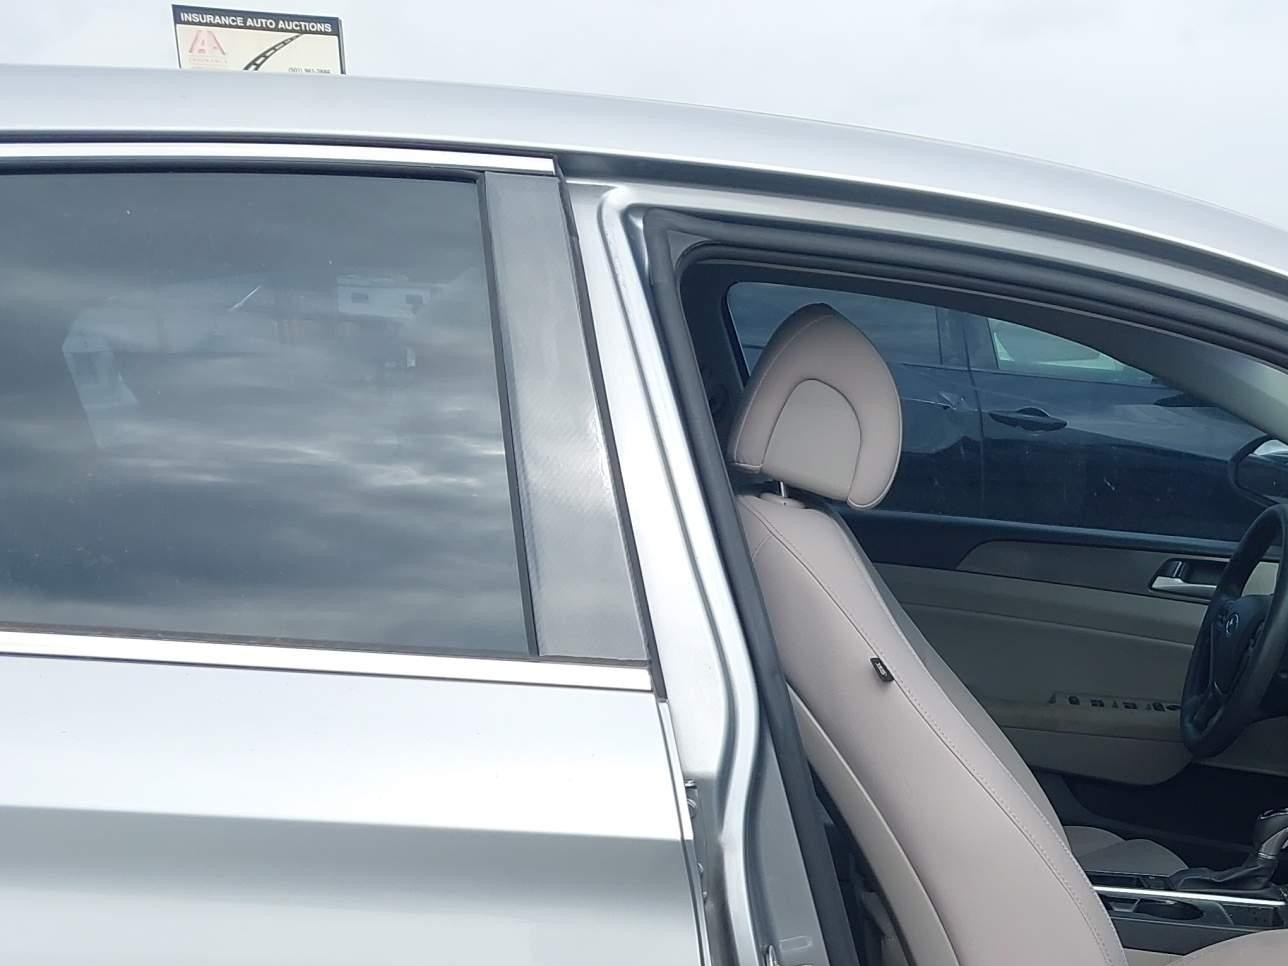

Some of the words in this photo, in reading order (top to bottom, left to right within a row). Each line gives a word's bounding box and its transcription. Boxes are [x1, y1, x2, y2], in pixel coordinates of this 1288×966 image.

[180, 12, 244, 27] INSURANCE
[246, 17, 276, 28] AUTO
[278, 20, 332, 33] AUCTIONS
